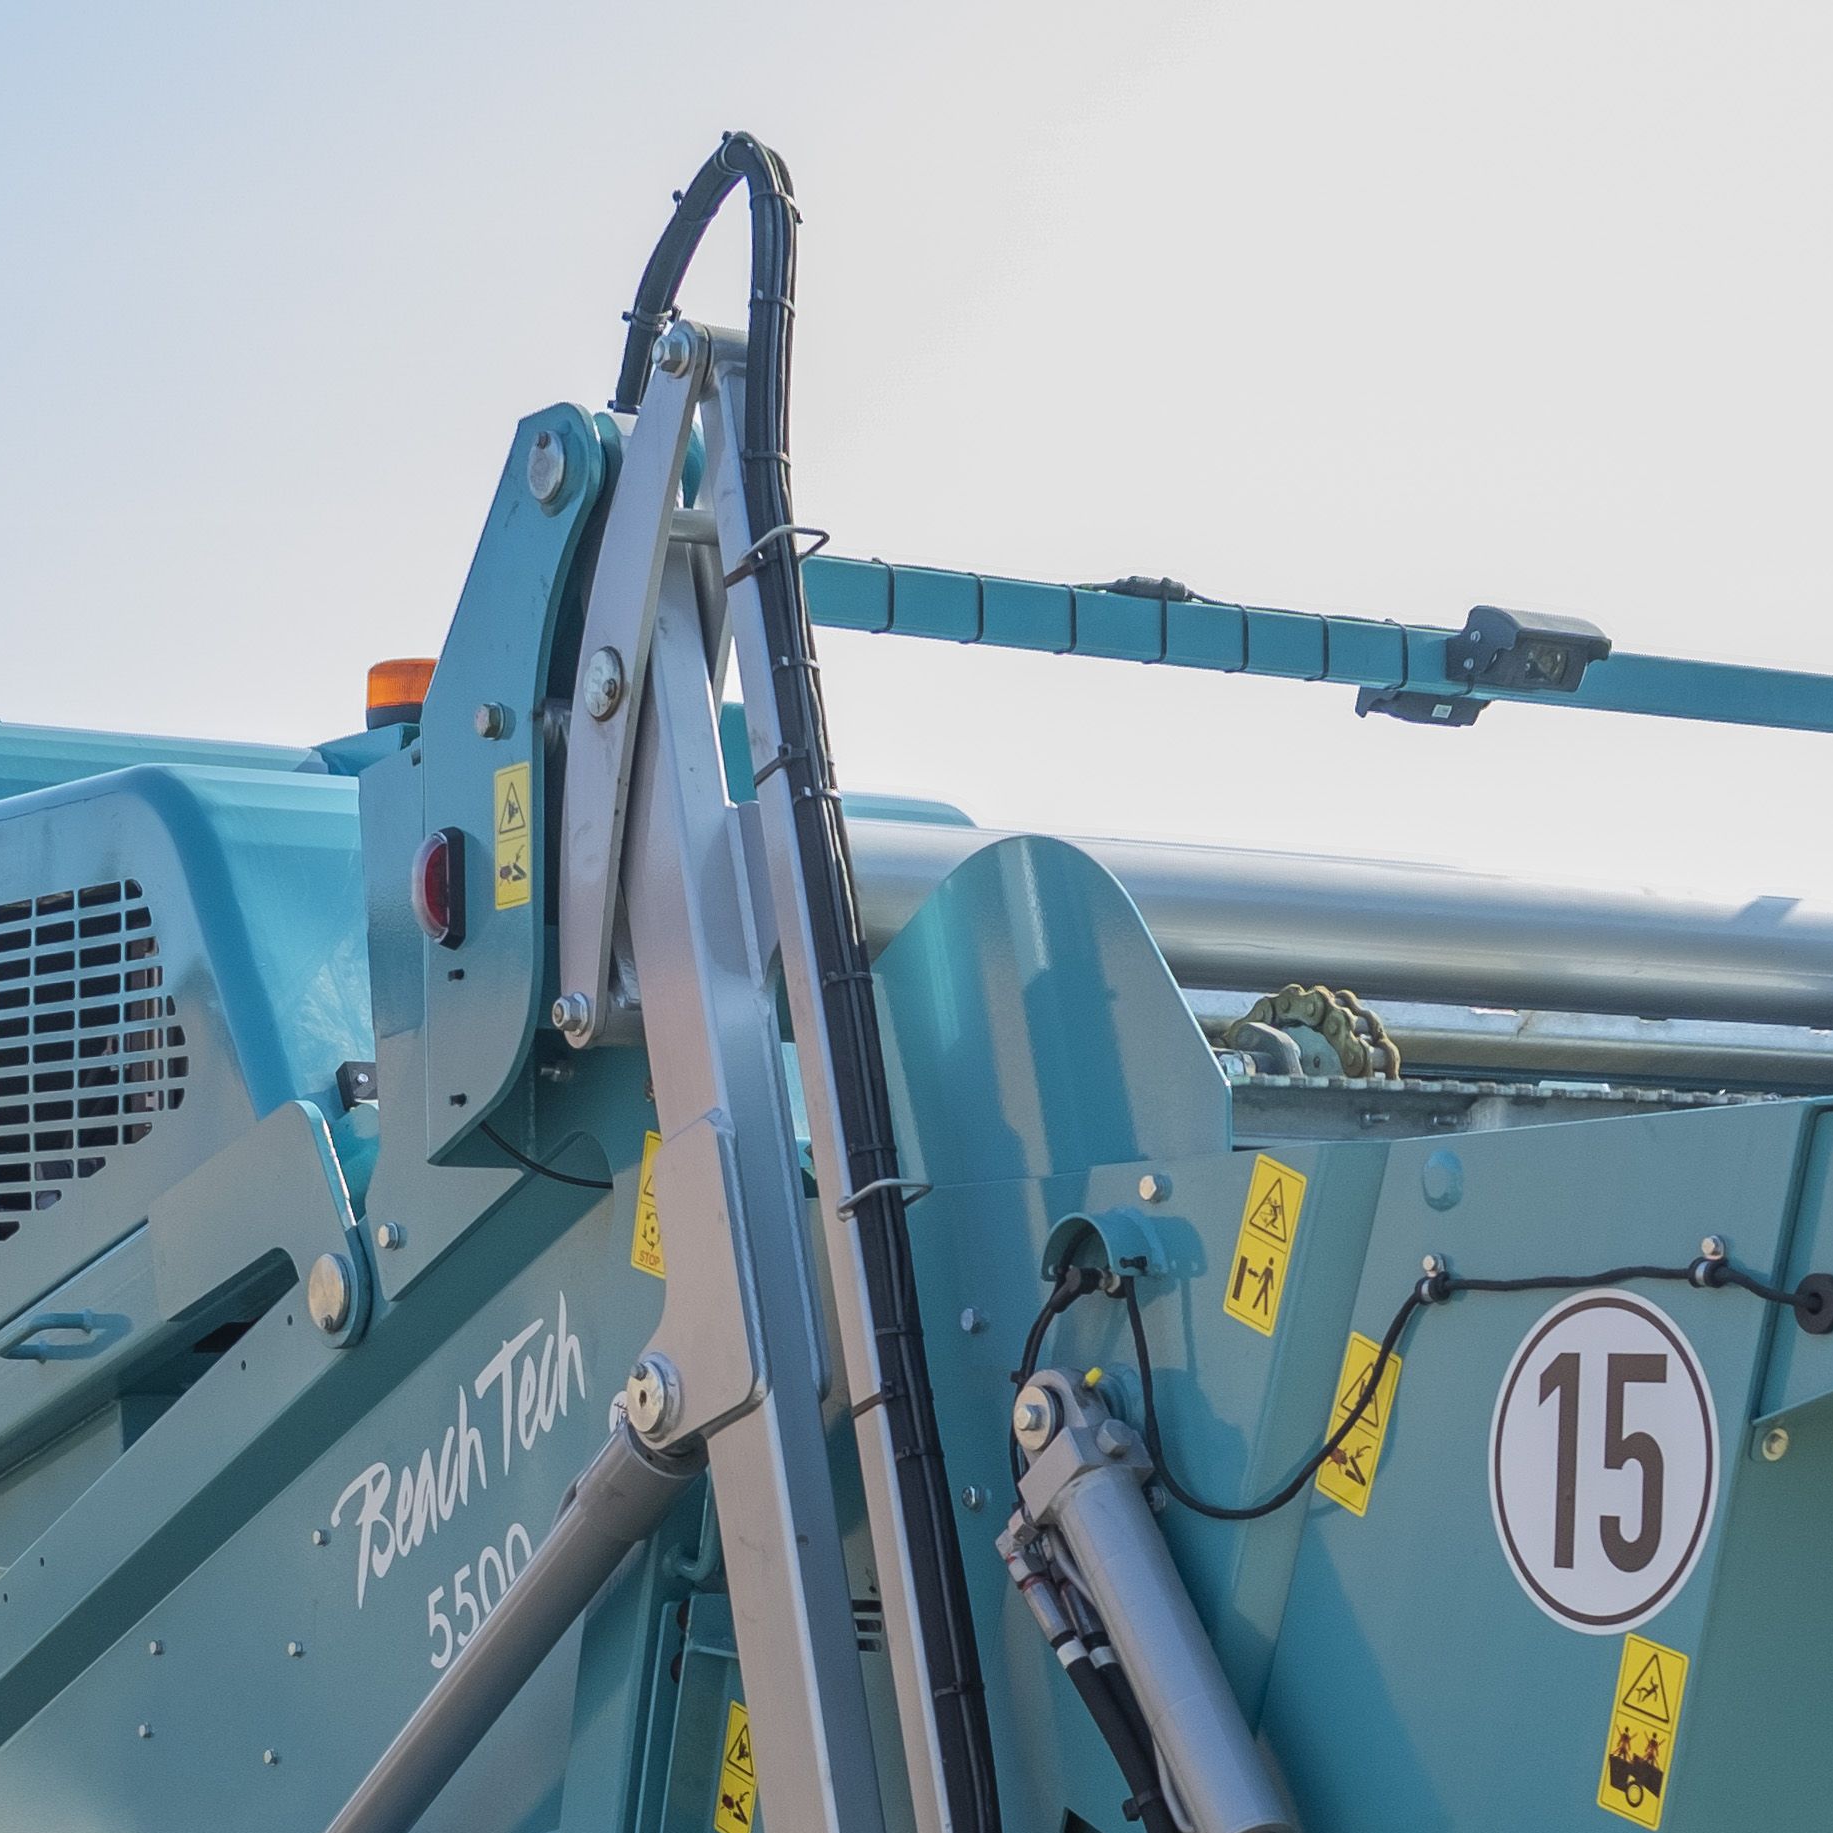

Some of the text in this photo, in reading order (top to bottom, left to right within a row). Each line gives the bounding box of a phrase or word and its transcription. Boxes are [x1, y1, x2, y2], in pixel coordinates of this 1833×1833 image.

[639, 1250, 661, 1267] STOP
[331, 1289, 587, 1610] Beach Tech
[1538, 1352, 1668, 1573] 15
